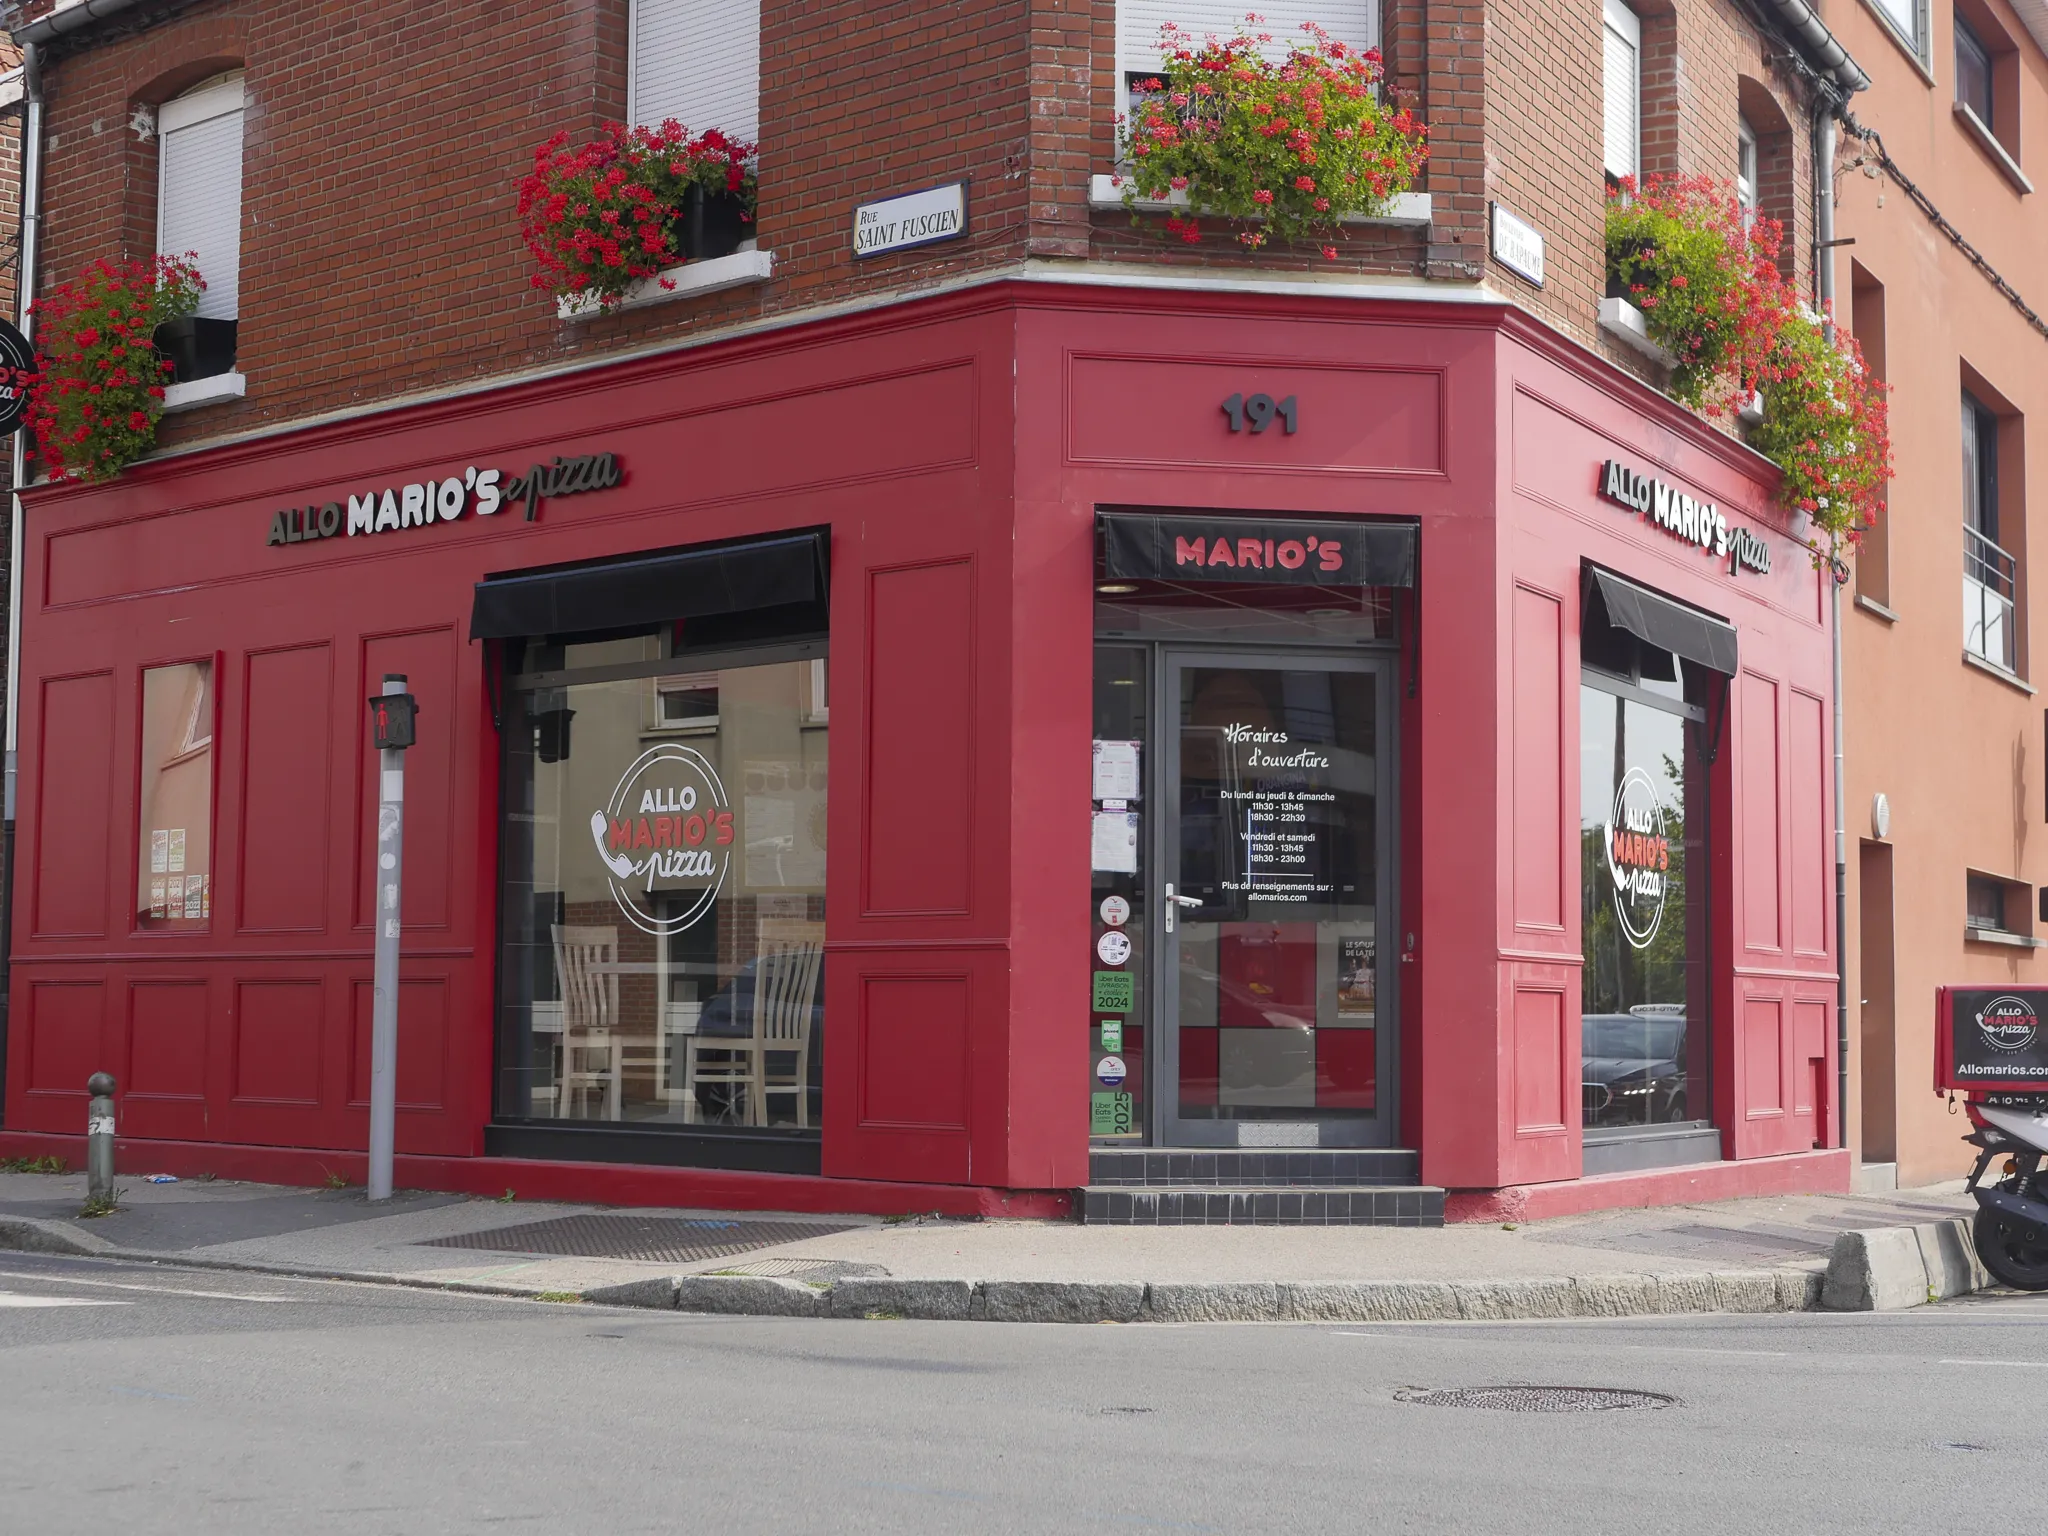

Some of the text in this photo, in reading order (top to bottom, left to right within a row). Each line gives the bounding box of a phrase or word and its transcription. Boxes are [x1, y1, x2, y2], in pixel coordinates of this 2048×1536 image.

[857, 209, 959, 250] SAINT FUSCIEN
[1510, 240, 1541, 277] BAPAUME
[1221, 393, 1298, 434] 191
[266, 502, 343, 546] ALLO
[347, 466, 502, 537] MARIO'S
[1604, 459, 1651, 513] ALLO
[1653, 478, 1728, 557] MARIO'S
[1175, 535, 1344, 572] MARIO'S
[1226, 722, 1288, 744] Horaires
[1248, 747, 1329, 768] d'ouverture
[639, 786, 697, 814] ALLO
[1220, 791, 1233, 799] Du
[1234, 791, 1254, 800] lundi
[1266, 792, 1287, 802] jeudi
[1288, 792, 1295, 800] &
[1296, 792, 1335, 801] dimanche
[1252, 802, 1274, 811] 11h30
[1281, 803, 1304, 811] 13h45
[1251, 813, 1274, 822] 18h30
[1280, 814, 1306, 822] 22h30
[1627, 808, 1653, 834] ALLO
[609, 808, 735, 850] MARIO'S
[1277, 833, 1286, 841] et
[1287, 833, 1316, 842] samedi
[1250, 854, 1274, 863] 18h30
[1280, 855, 1306, 863] 23h00
[1252, 844, 1274, 852] 11h30
[1281, 844, 1304, 853] 13h45
[1613, 831, 1669, 872] MARIO'S
[1221, 881, 1239, 890] Plus
[1240, 881, 1251, 890] de
[1252, 882, 1315, 893] renseignements
[1248, 893, 1308, 902] allomarios.com
[1346, 941, 1353, 949] LE
[1098, 997, 1129, 1008] 2024
[1996, 1008, 2022, 1016] ALLO
[1984, 1015, 2038, 1026] MARIO'S
[1114, 1092, 1129, 1134] 2025
